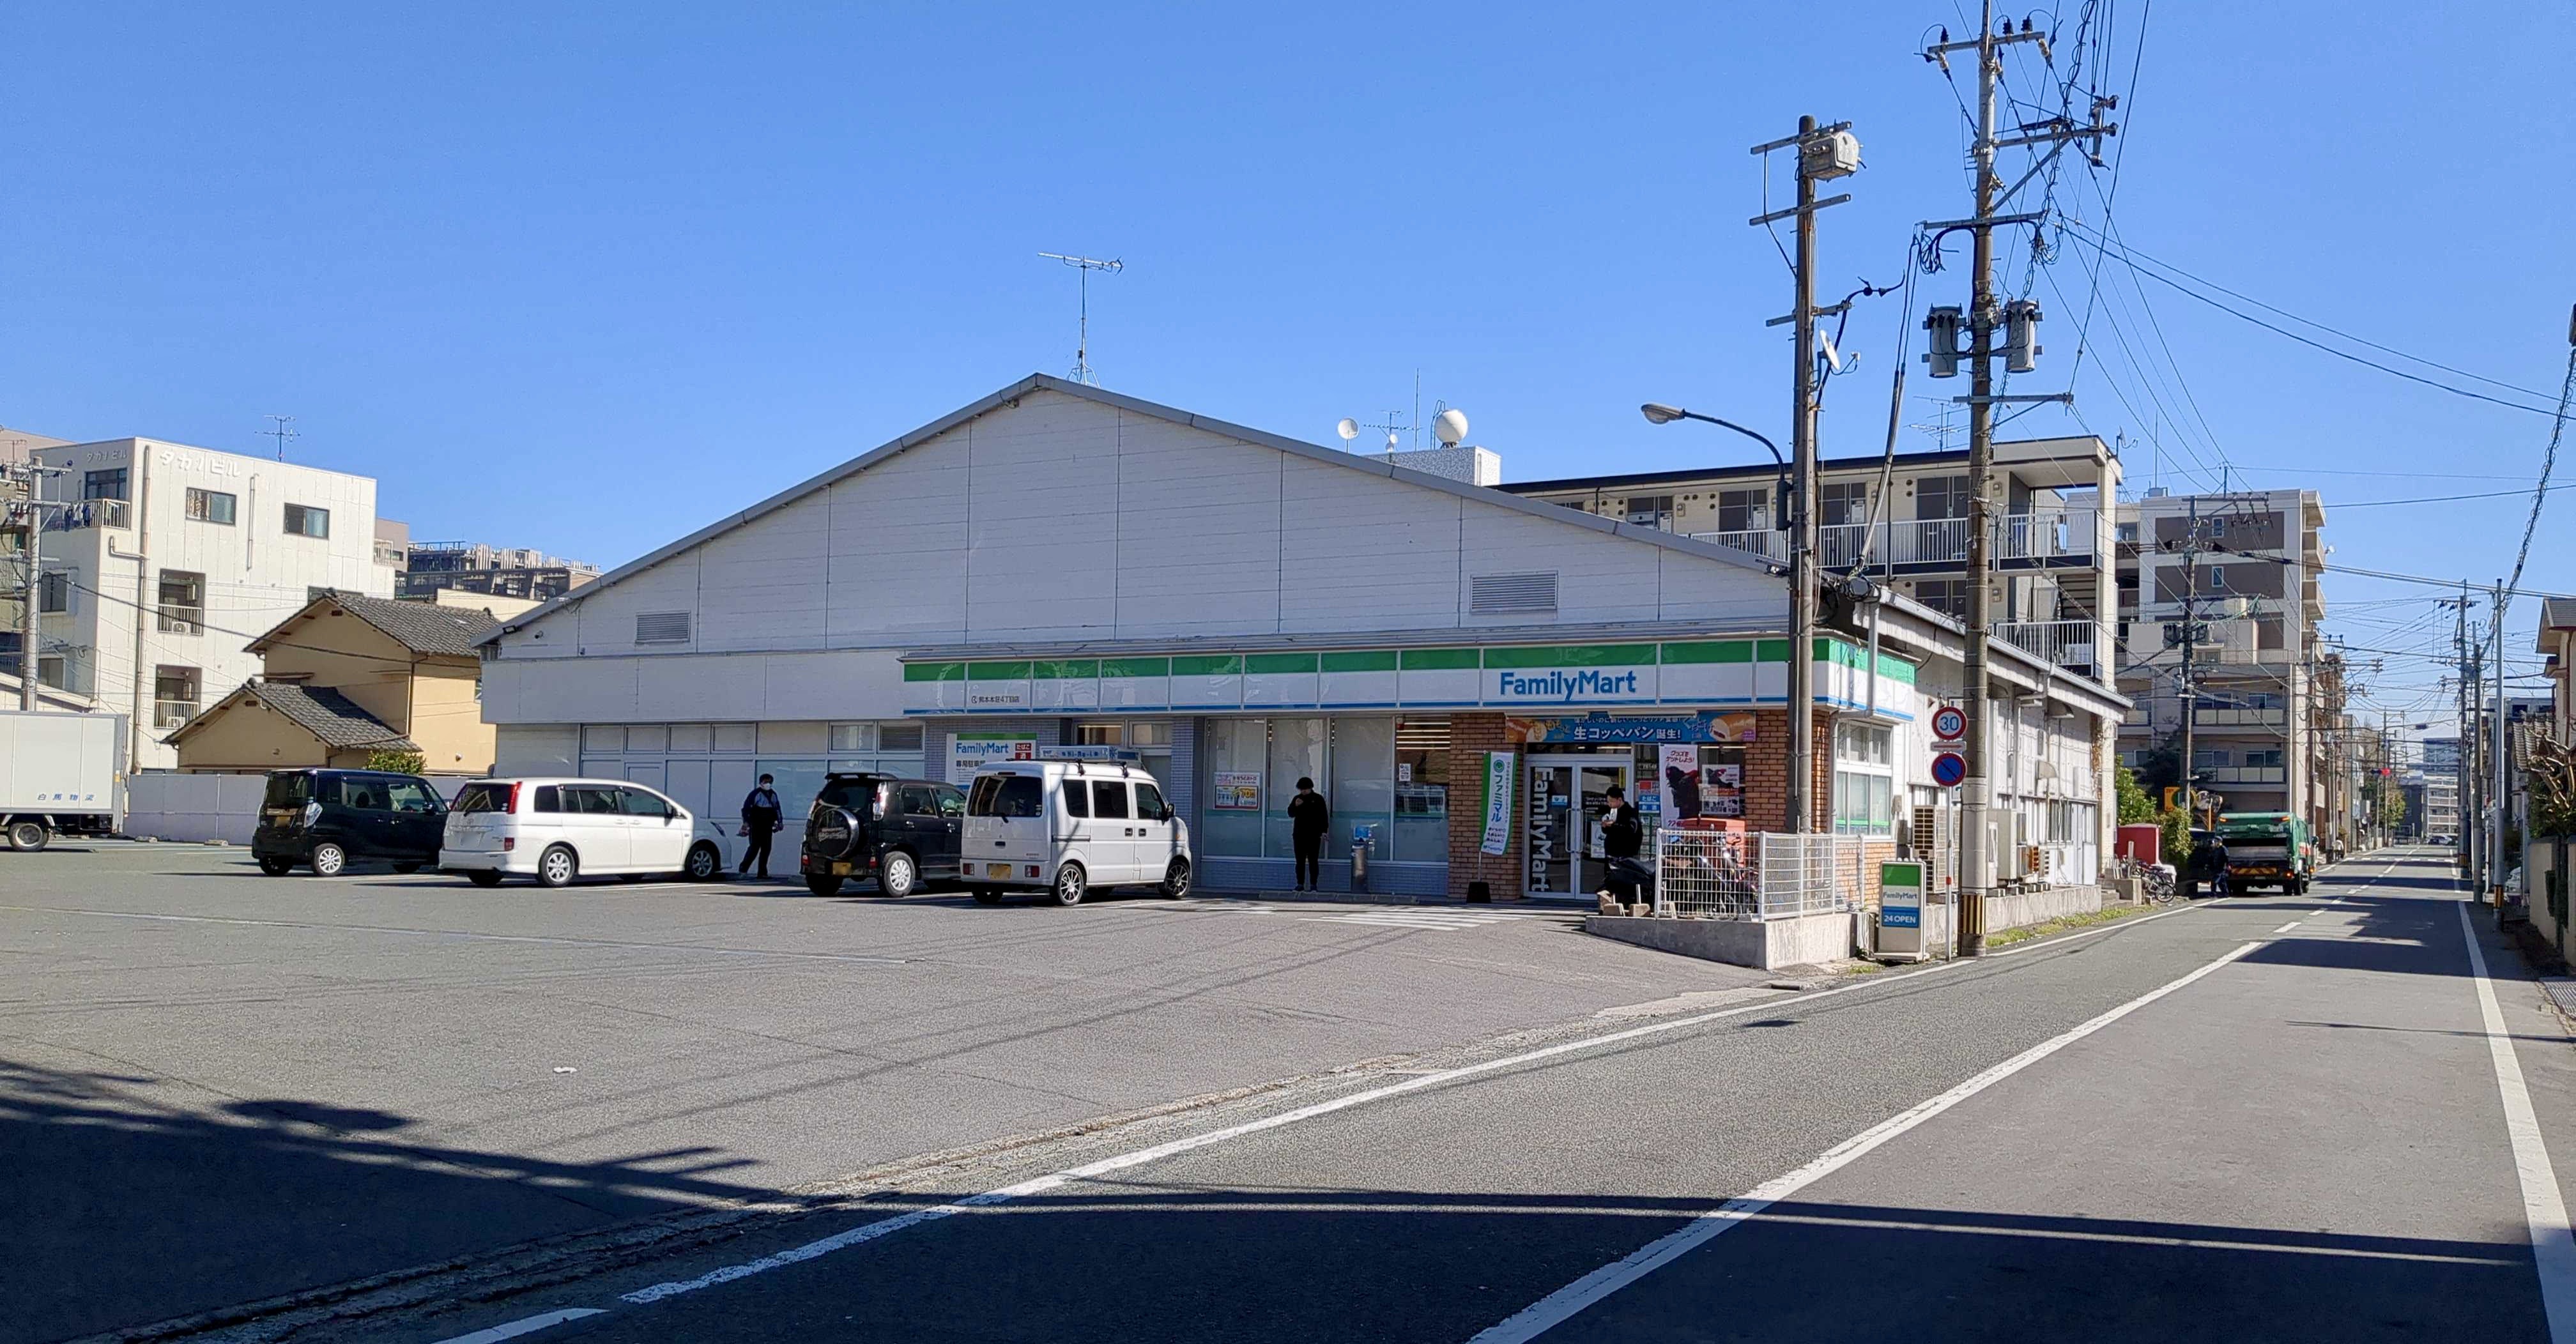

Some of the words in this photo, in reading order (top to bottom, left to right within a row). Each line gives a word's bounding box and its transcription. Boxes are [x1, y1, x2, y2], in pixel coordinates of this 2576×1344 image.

[160, 449, 241, 477] タカノビル
[1500, 671, 1637, 701] FamilyMart
[1940, 716, 1959, 731] 30
[1574, 726, 1653, 740] 生コッペパン
[956, 742, 1009, 757] FamilyMart
[1530, 767, 1554, 892] FamilyMart
[1883, 892, 1917, 900] FamilyMart
[1894, 915, 1916, 924] OPEN
